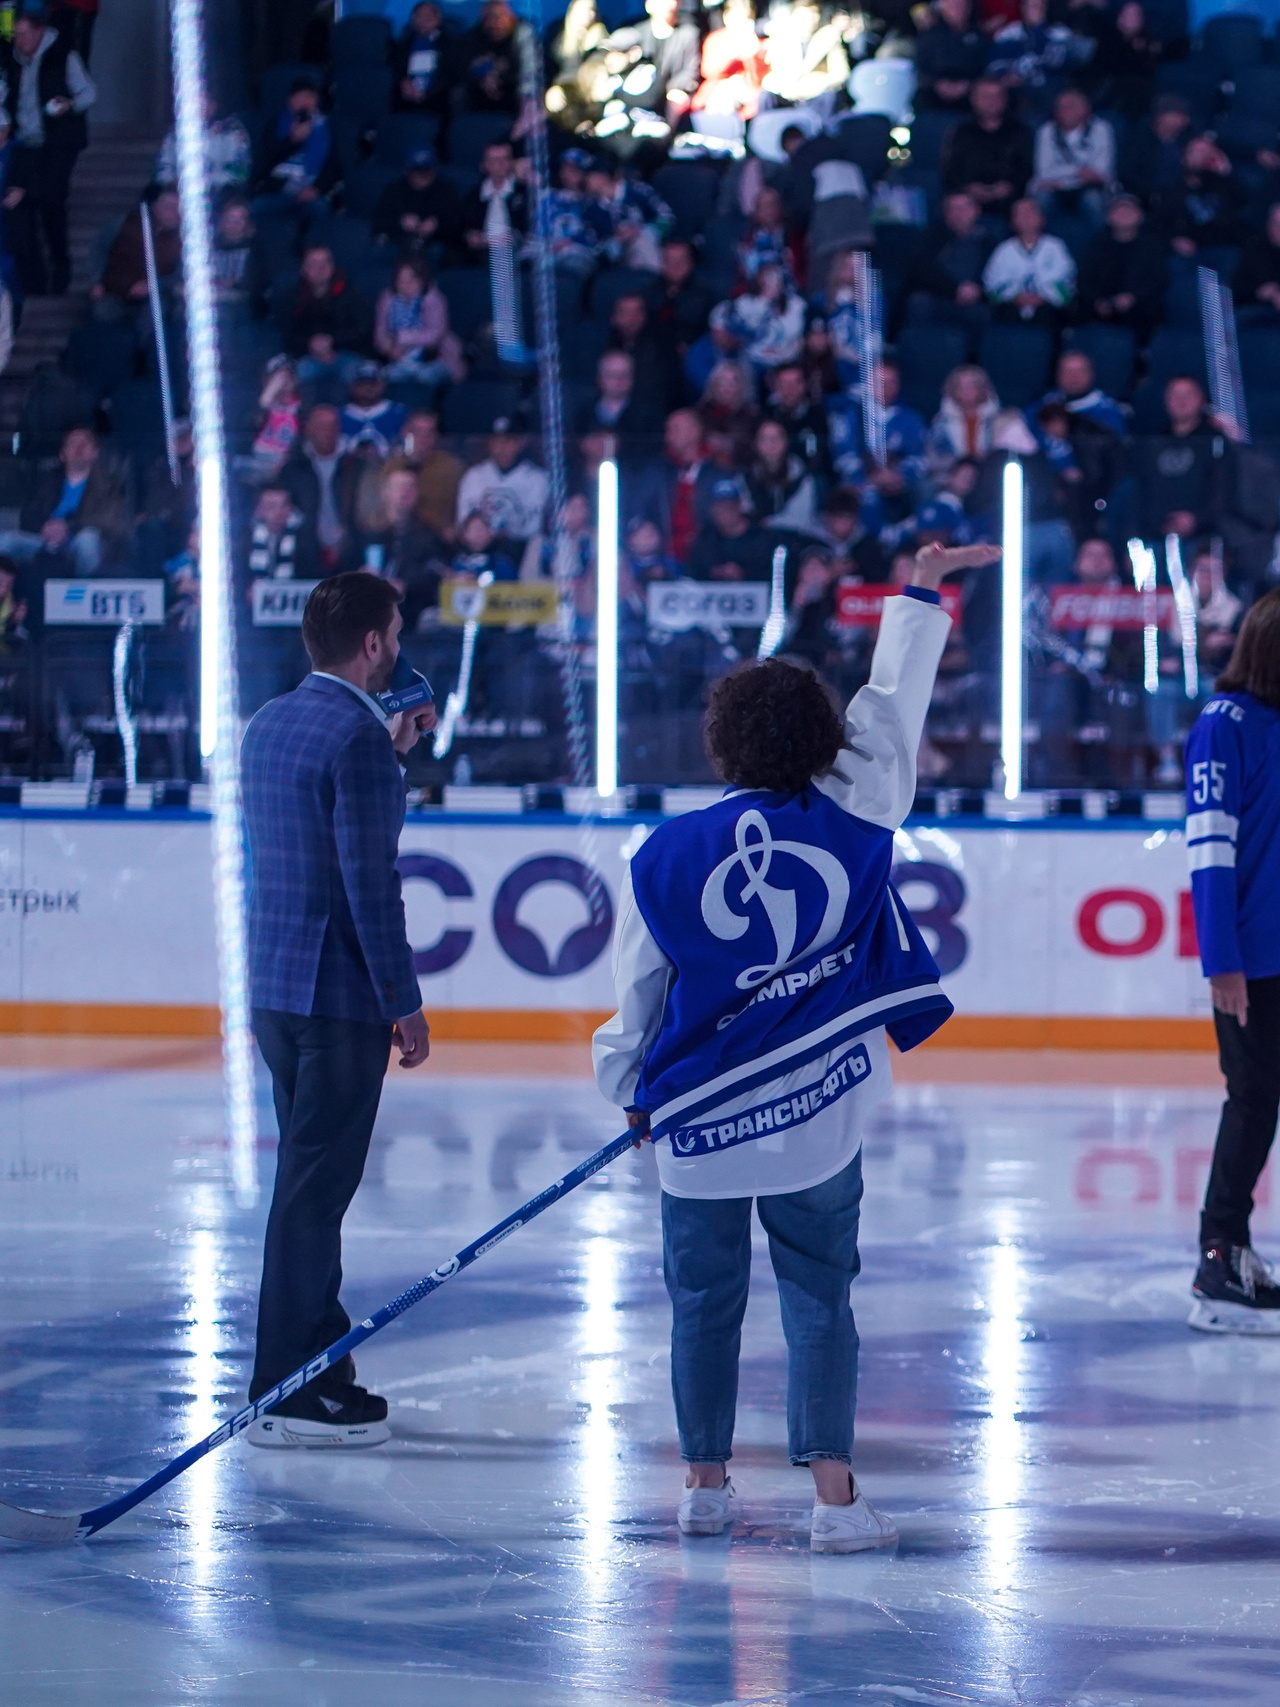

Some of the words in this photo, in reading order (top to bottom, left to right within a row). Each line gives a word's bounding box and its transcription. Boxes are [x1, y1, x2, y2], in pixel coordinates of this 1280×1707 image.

[1193, 760, 1227, 805] 55
[399, 850, 969, 979] СОЗ
[716, 942, 856, 1031] OMPBET
[700, 1053, 868, 1148] ТРАНСНЕФТЬ
